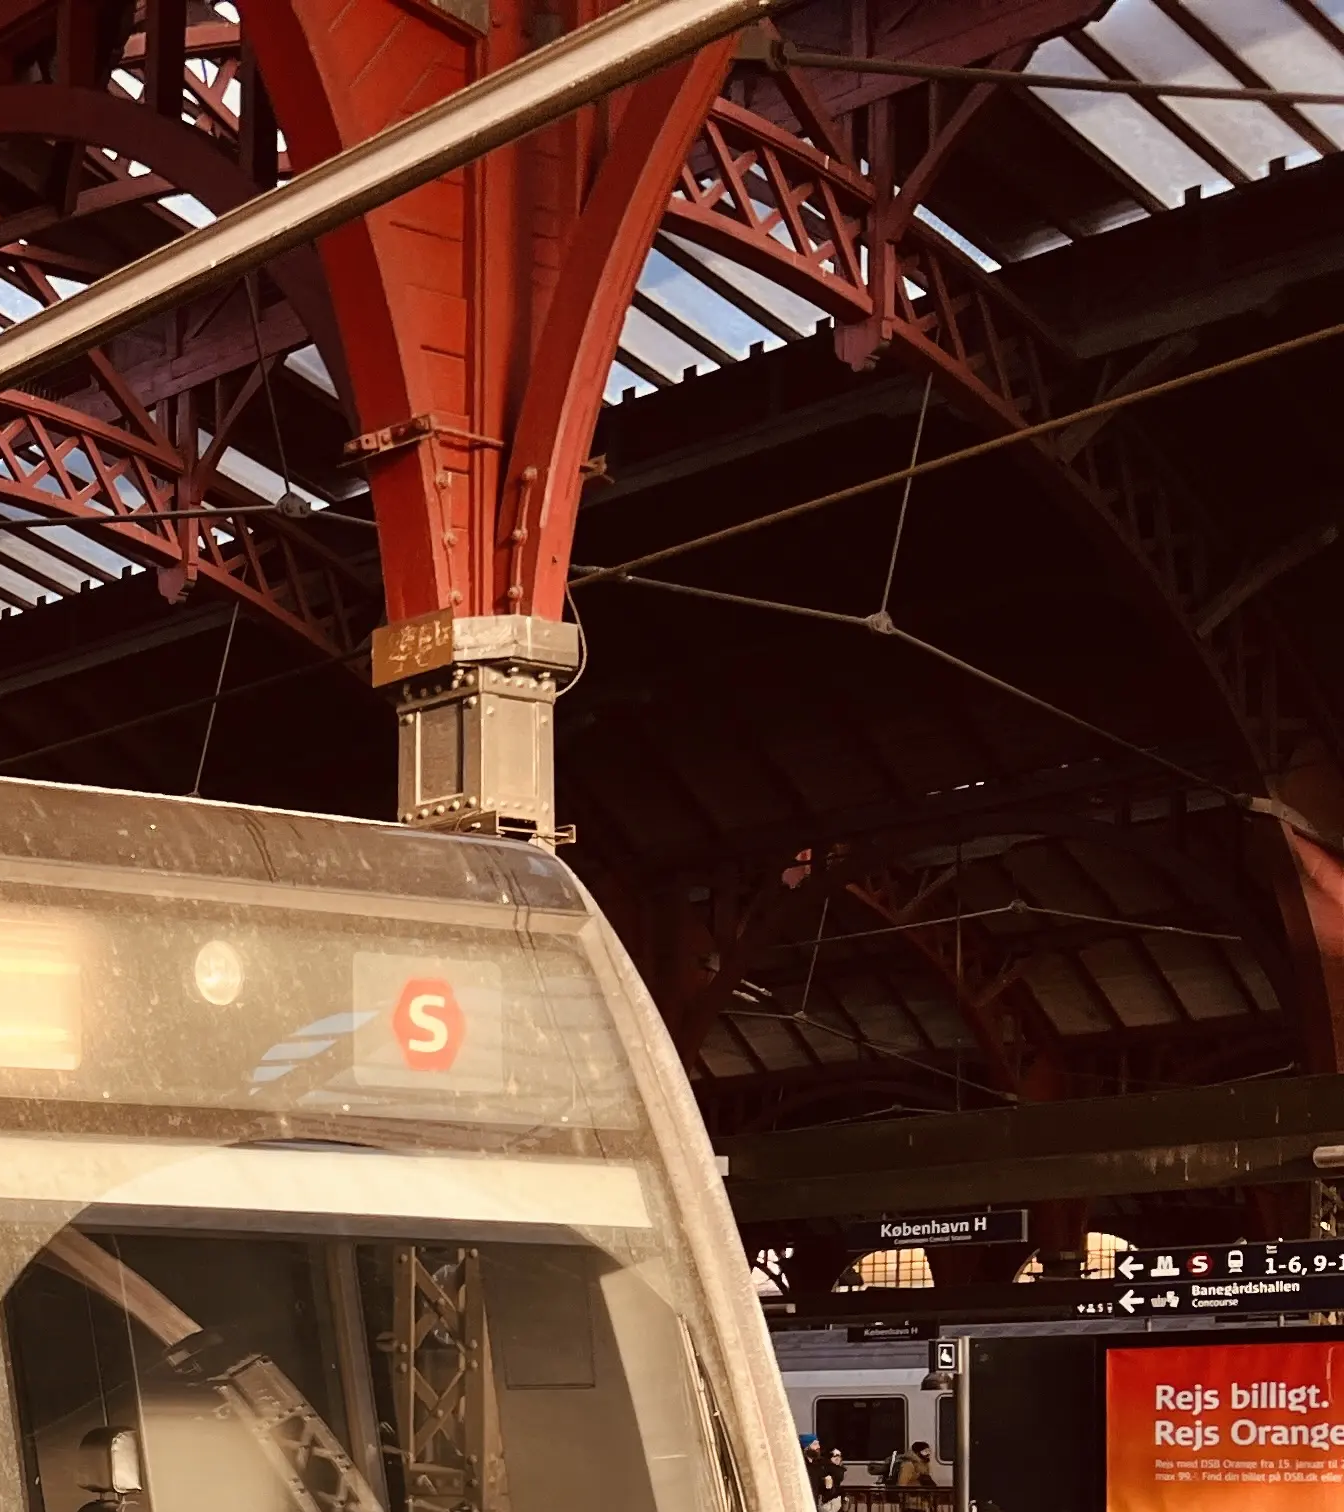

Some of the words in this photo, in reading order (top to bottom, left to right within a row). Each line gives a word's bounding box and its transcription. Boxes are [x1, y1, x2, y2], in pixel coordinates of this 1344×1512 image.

[409, 995, 450, 1053] S
[881, 1220, 969, 1237] København
[974, 1217, 987, 1231] H
[1192, 1256, 1208, 1273] S
[1265, 1256, 1308, 1275] 1-6,
[1192, 1281, 1300, 1297] Banegårdshallen
[1192, 1298, 1239, 1308] Concourse
[1155, 1384, 1220, 1416] Rejs
[1231, 1382, 1330, 1414] billigt.
[1154, 1420, 1220, 1451] Rejs
[1230, 1418, 1344, 1451] Orange
[1176, 1459, 1198, 1469] med
[1200, 1459, 1220, 1469] DSB
[1223, 1459, 1257, 1470] Orange
[1260, 1459, 1274, 1469] fra
[1295, 1459, 1324, 1470] januar
[1328, 1459, 1338, 1469] til
[1202, 1472, 1222, 1481] Find
[1225, 1472, 1239, 1481] din
[1269, 1472, 1281, 1483] på
[1284, 1472, 1318, 1481] DSB.dk
